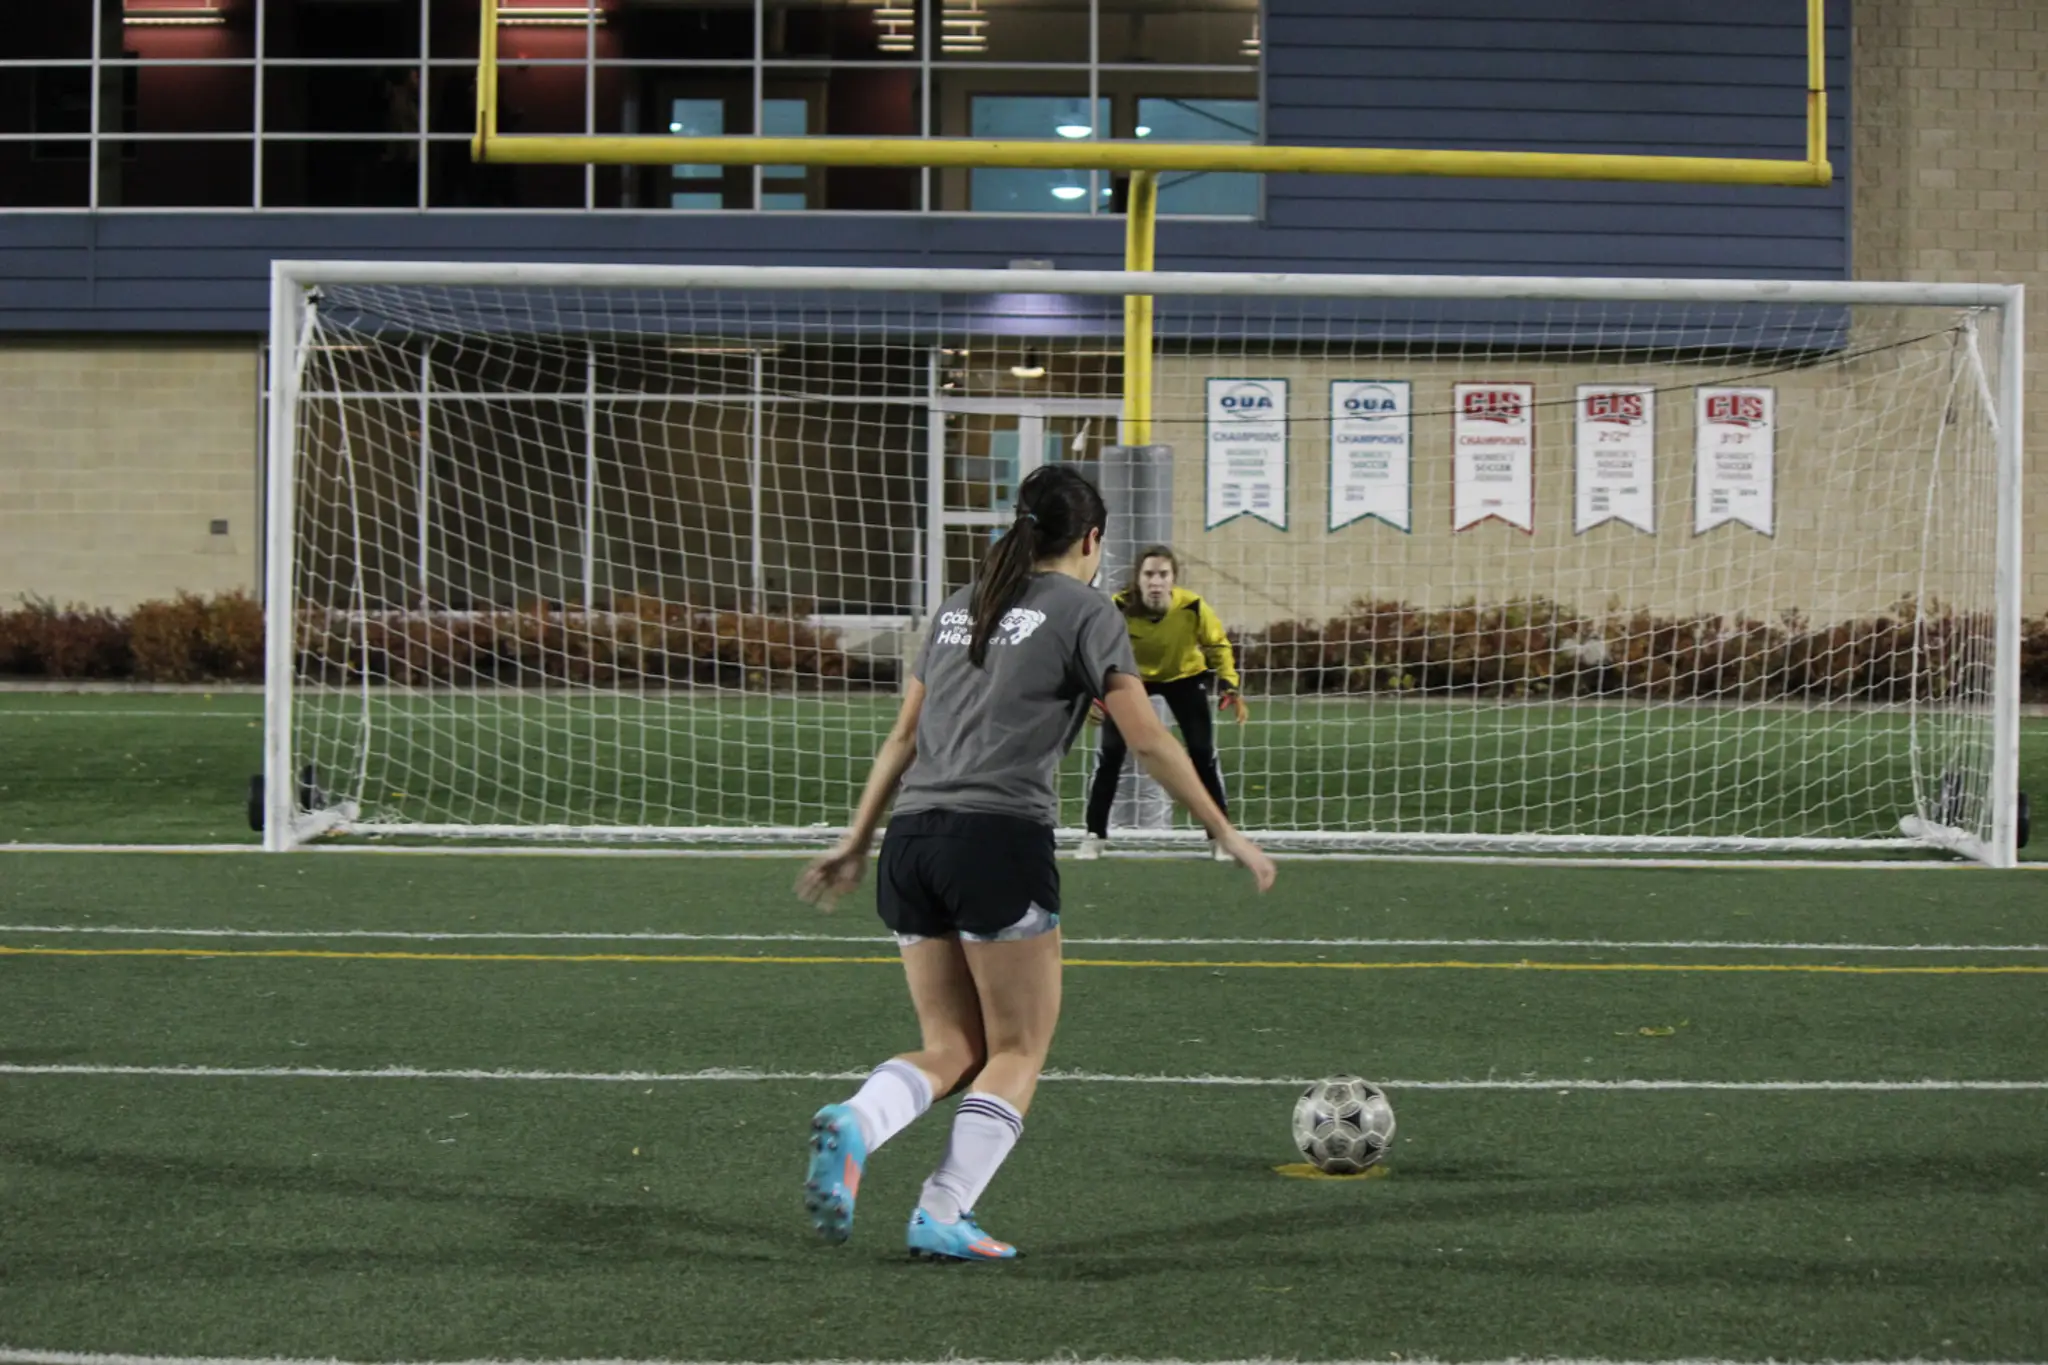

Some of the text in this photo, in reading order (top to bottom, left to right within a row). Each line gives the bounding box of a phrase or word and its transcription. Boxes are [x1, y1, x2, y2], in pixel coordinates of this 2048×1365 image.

[1220, 396, 1273, 409] OUA
[1344, 398, 1397, 410] OUA
[1465, 392, 1521, 415] CIS
[1587, 394, 1643, 417] CIS
[1707, 395, 1763, 418] CIS
[1213, 432, 1281, 442] CHAMPIONS
[1337, 434, 1404, 444] CHAMPIONS
[1460, 436, 1527, 446] CHAMPIONS
